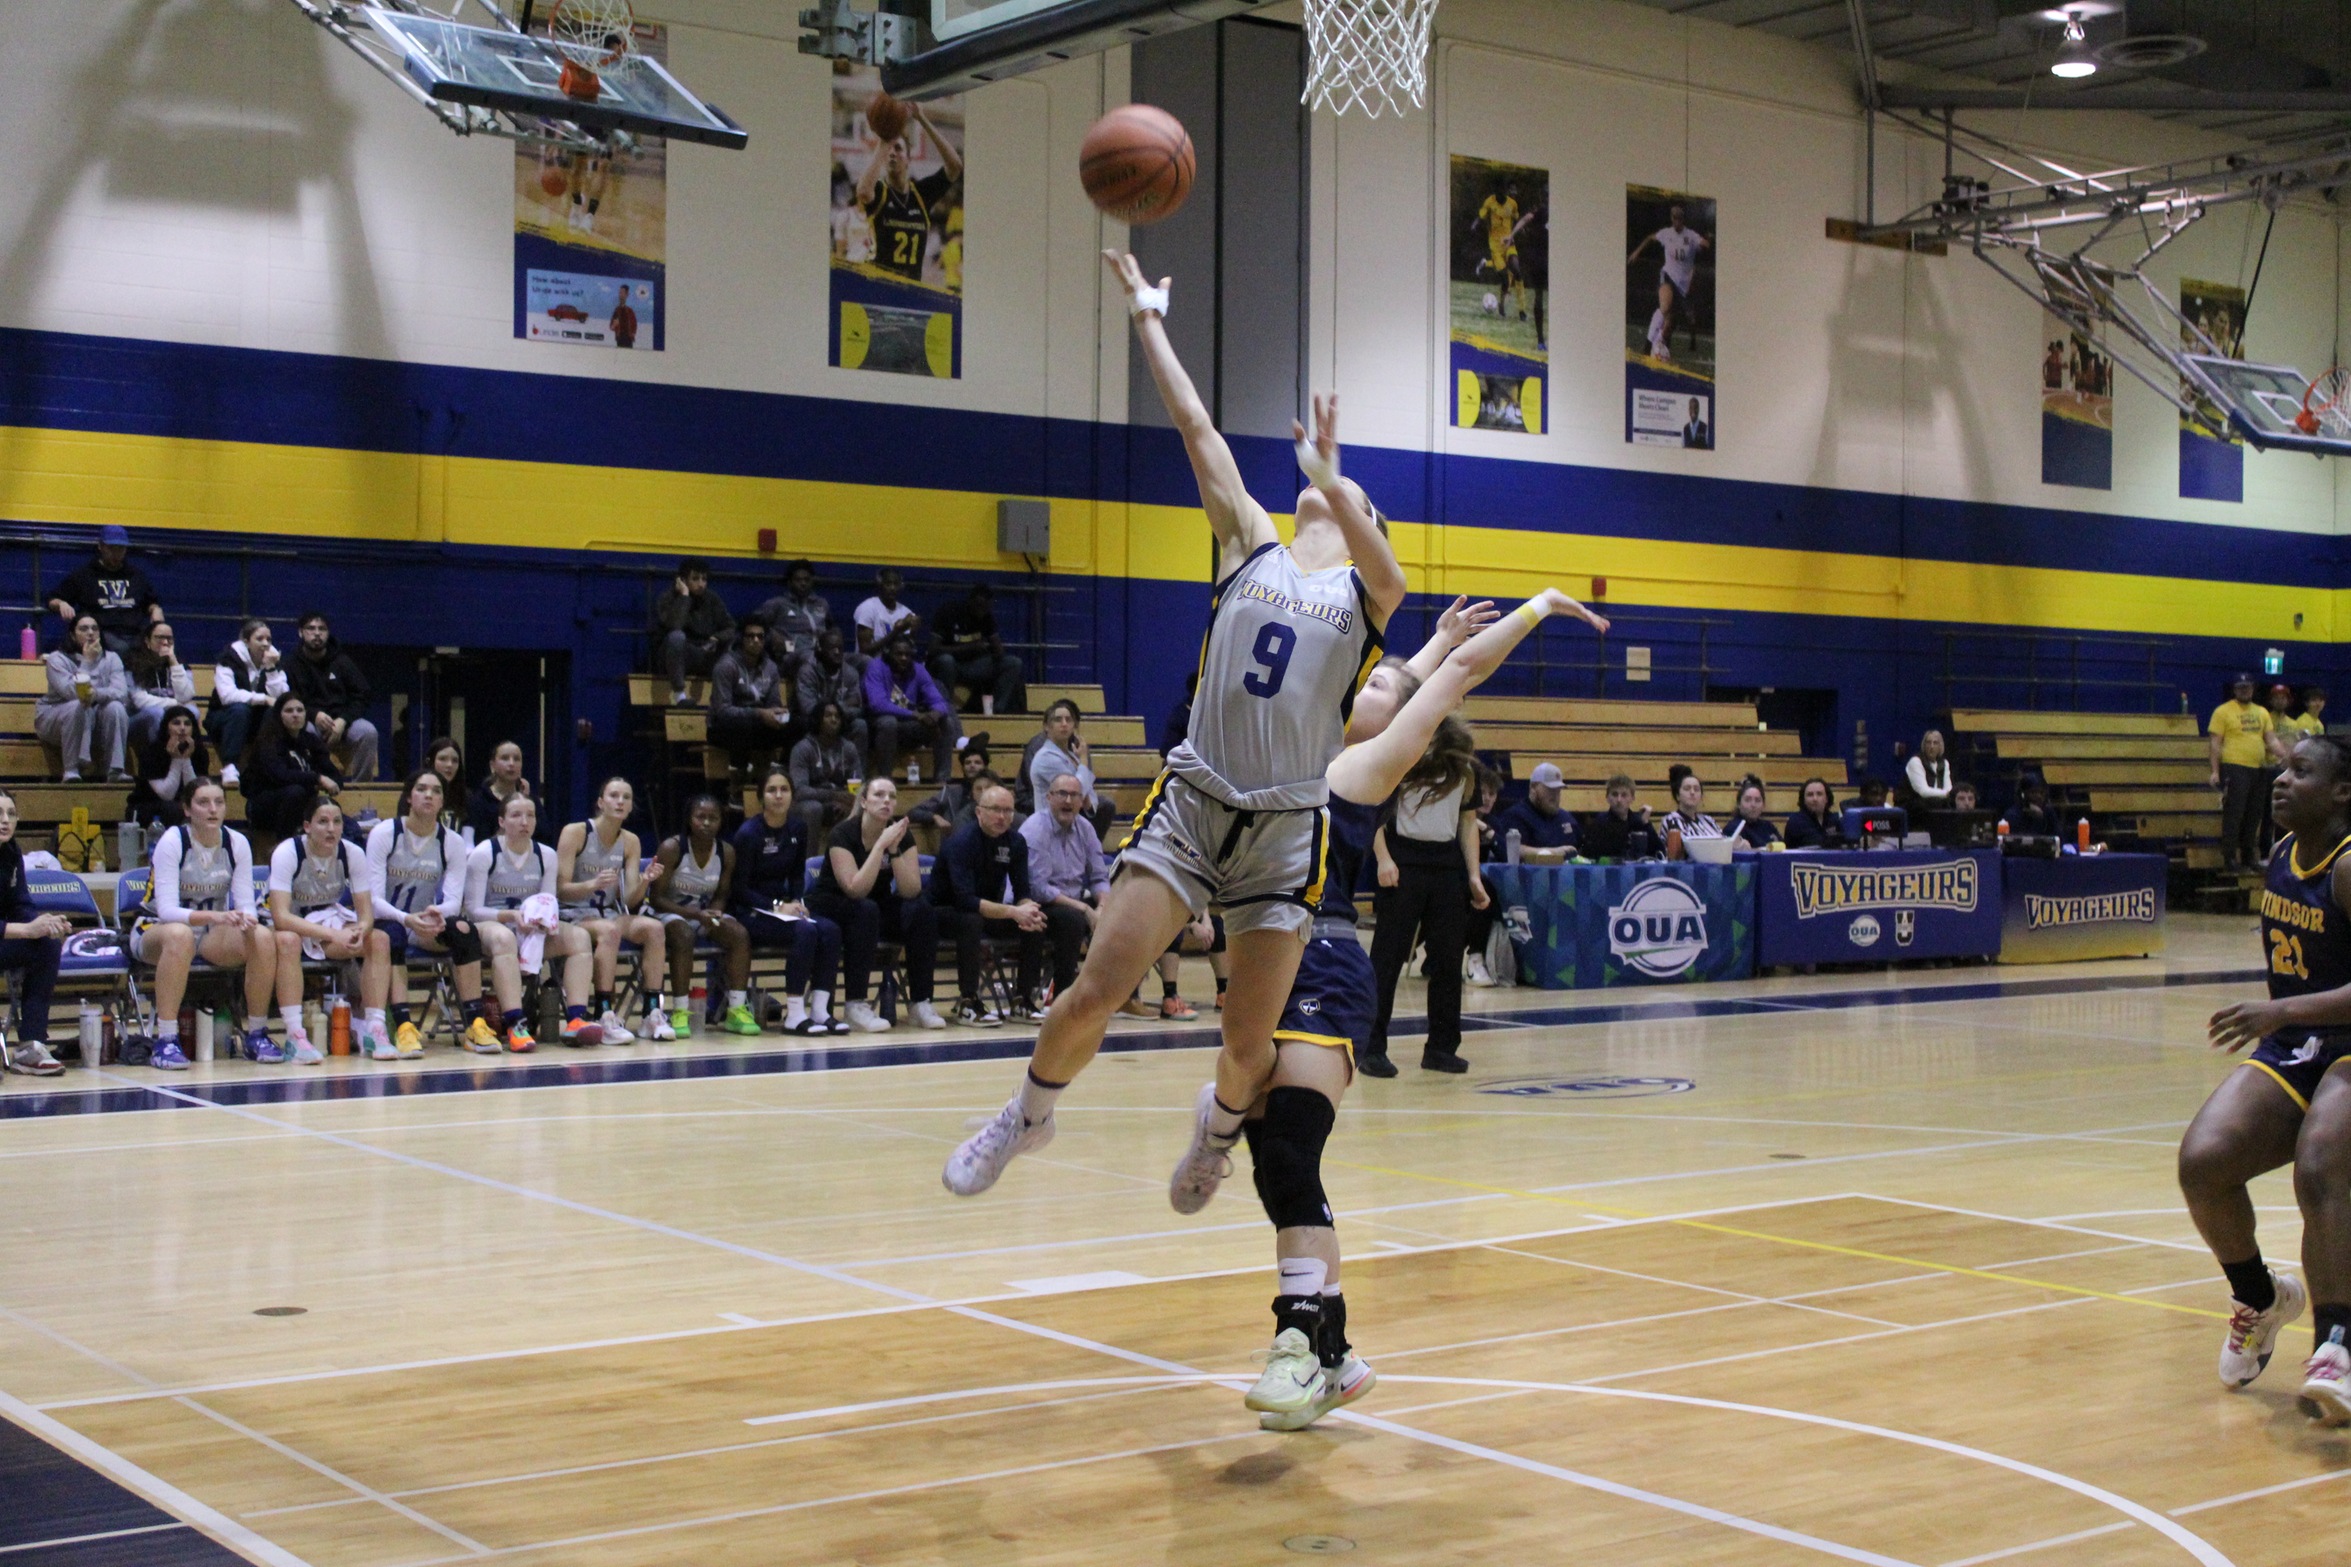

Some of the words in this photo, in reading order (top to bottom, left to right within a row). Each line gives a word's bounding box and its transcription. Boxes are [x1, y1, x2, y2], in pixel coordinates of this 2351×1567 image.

[893, 231, 919, 265] 21
[1243, 621, 1297, 699] 9
[27, 881, 81, 894] YAGEURS
[1793, 859, 1977, 917] VOYAGEURS
[2025, 888, 2154, 928] VOYAGEURS
[1613, 914, 1704, 945] OUA
[1850, 926, 1878, 936] OUA
[2269, 928, 2309, 980] 21
